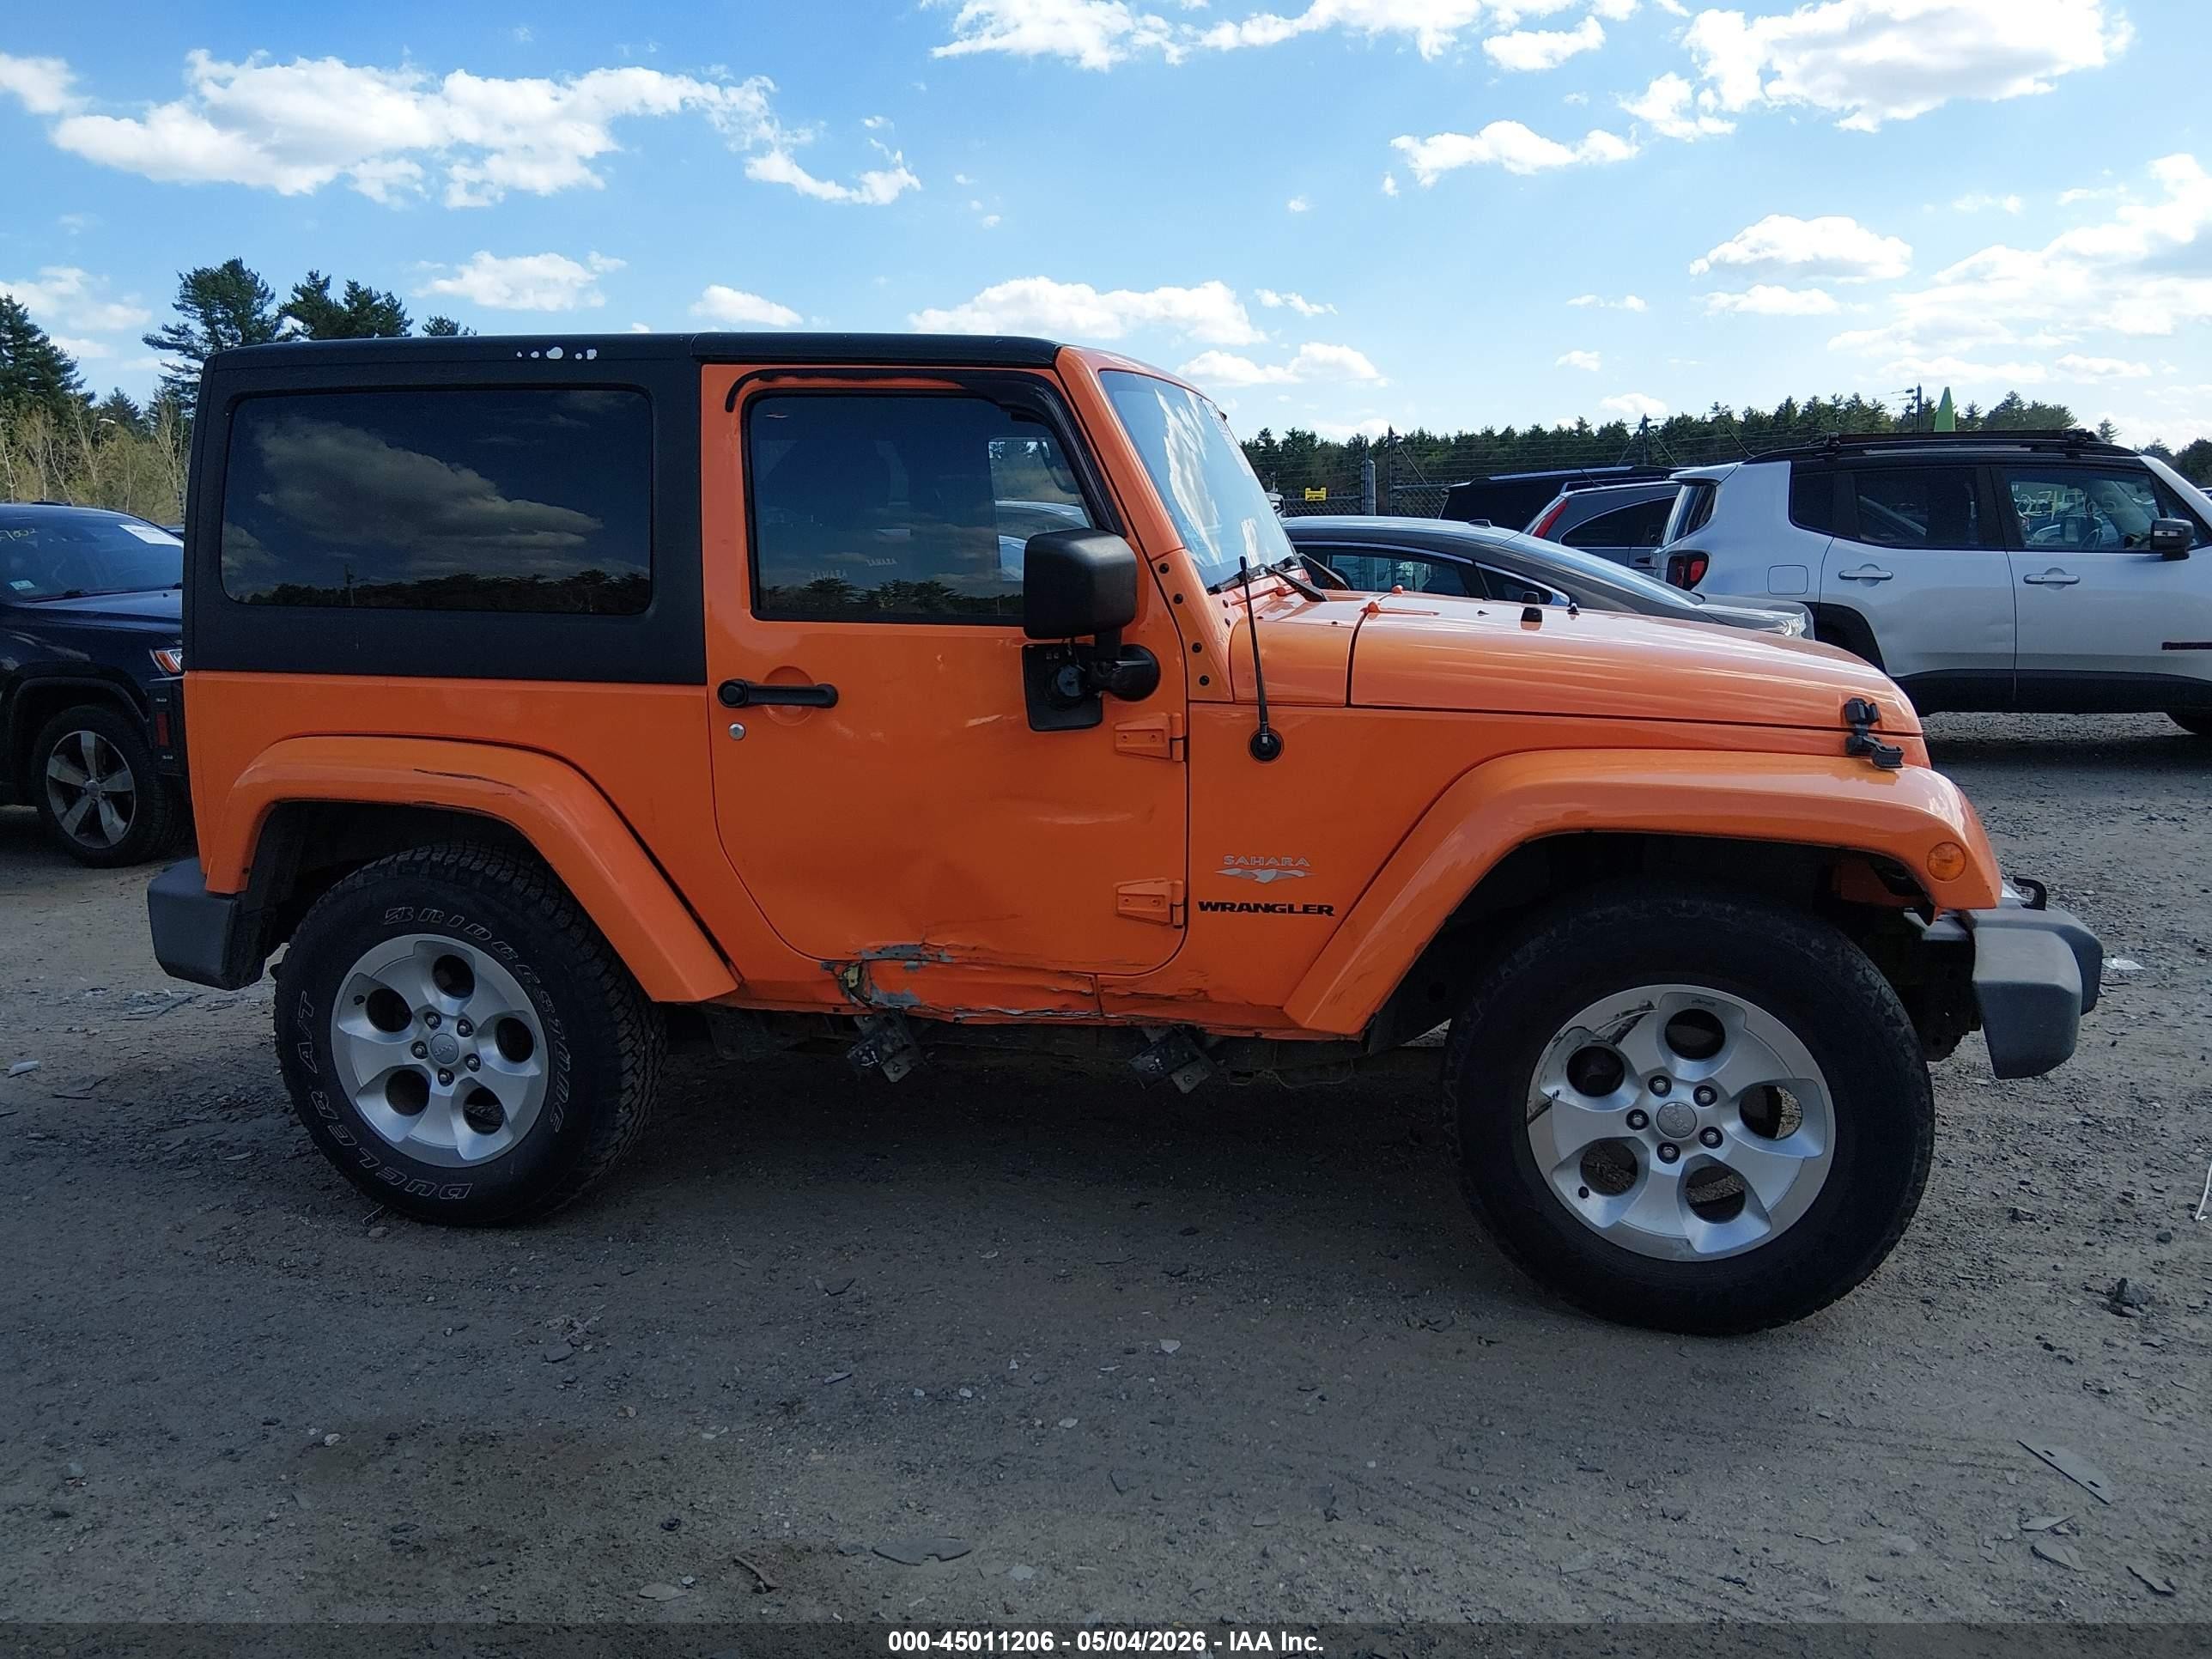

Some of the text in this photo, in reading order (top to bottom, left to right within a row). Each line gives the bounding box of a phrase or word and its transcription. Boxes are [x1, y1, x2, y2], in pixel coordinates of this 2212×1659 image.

[1198, 901, 1335, 916] WRANGLER
[1223, 854, 1311, 866] SAHARA
[384, 907, 571, 1133] BRIDGESTONE
[298, 991, 473, 1200] DUELER A/T
